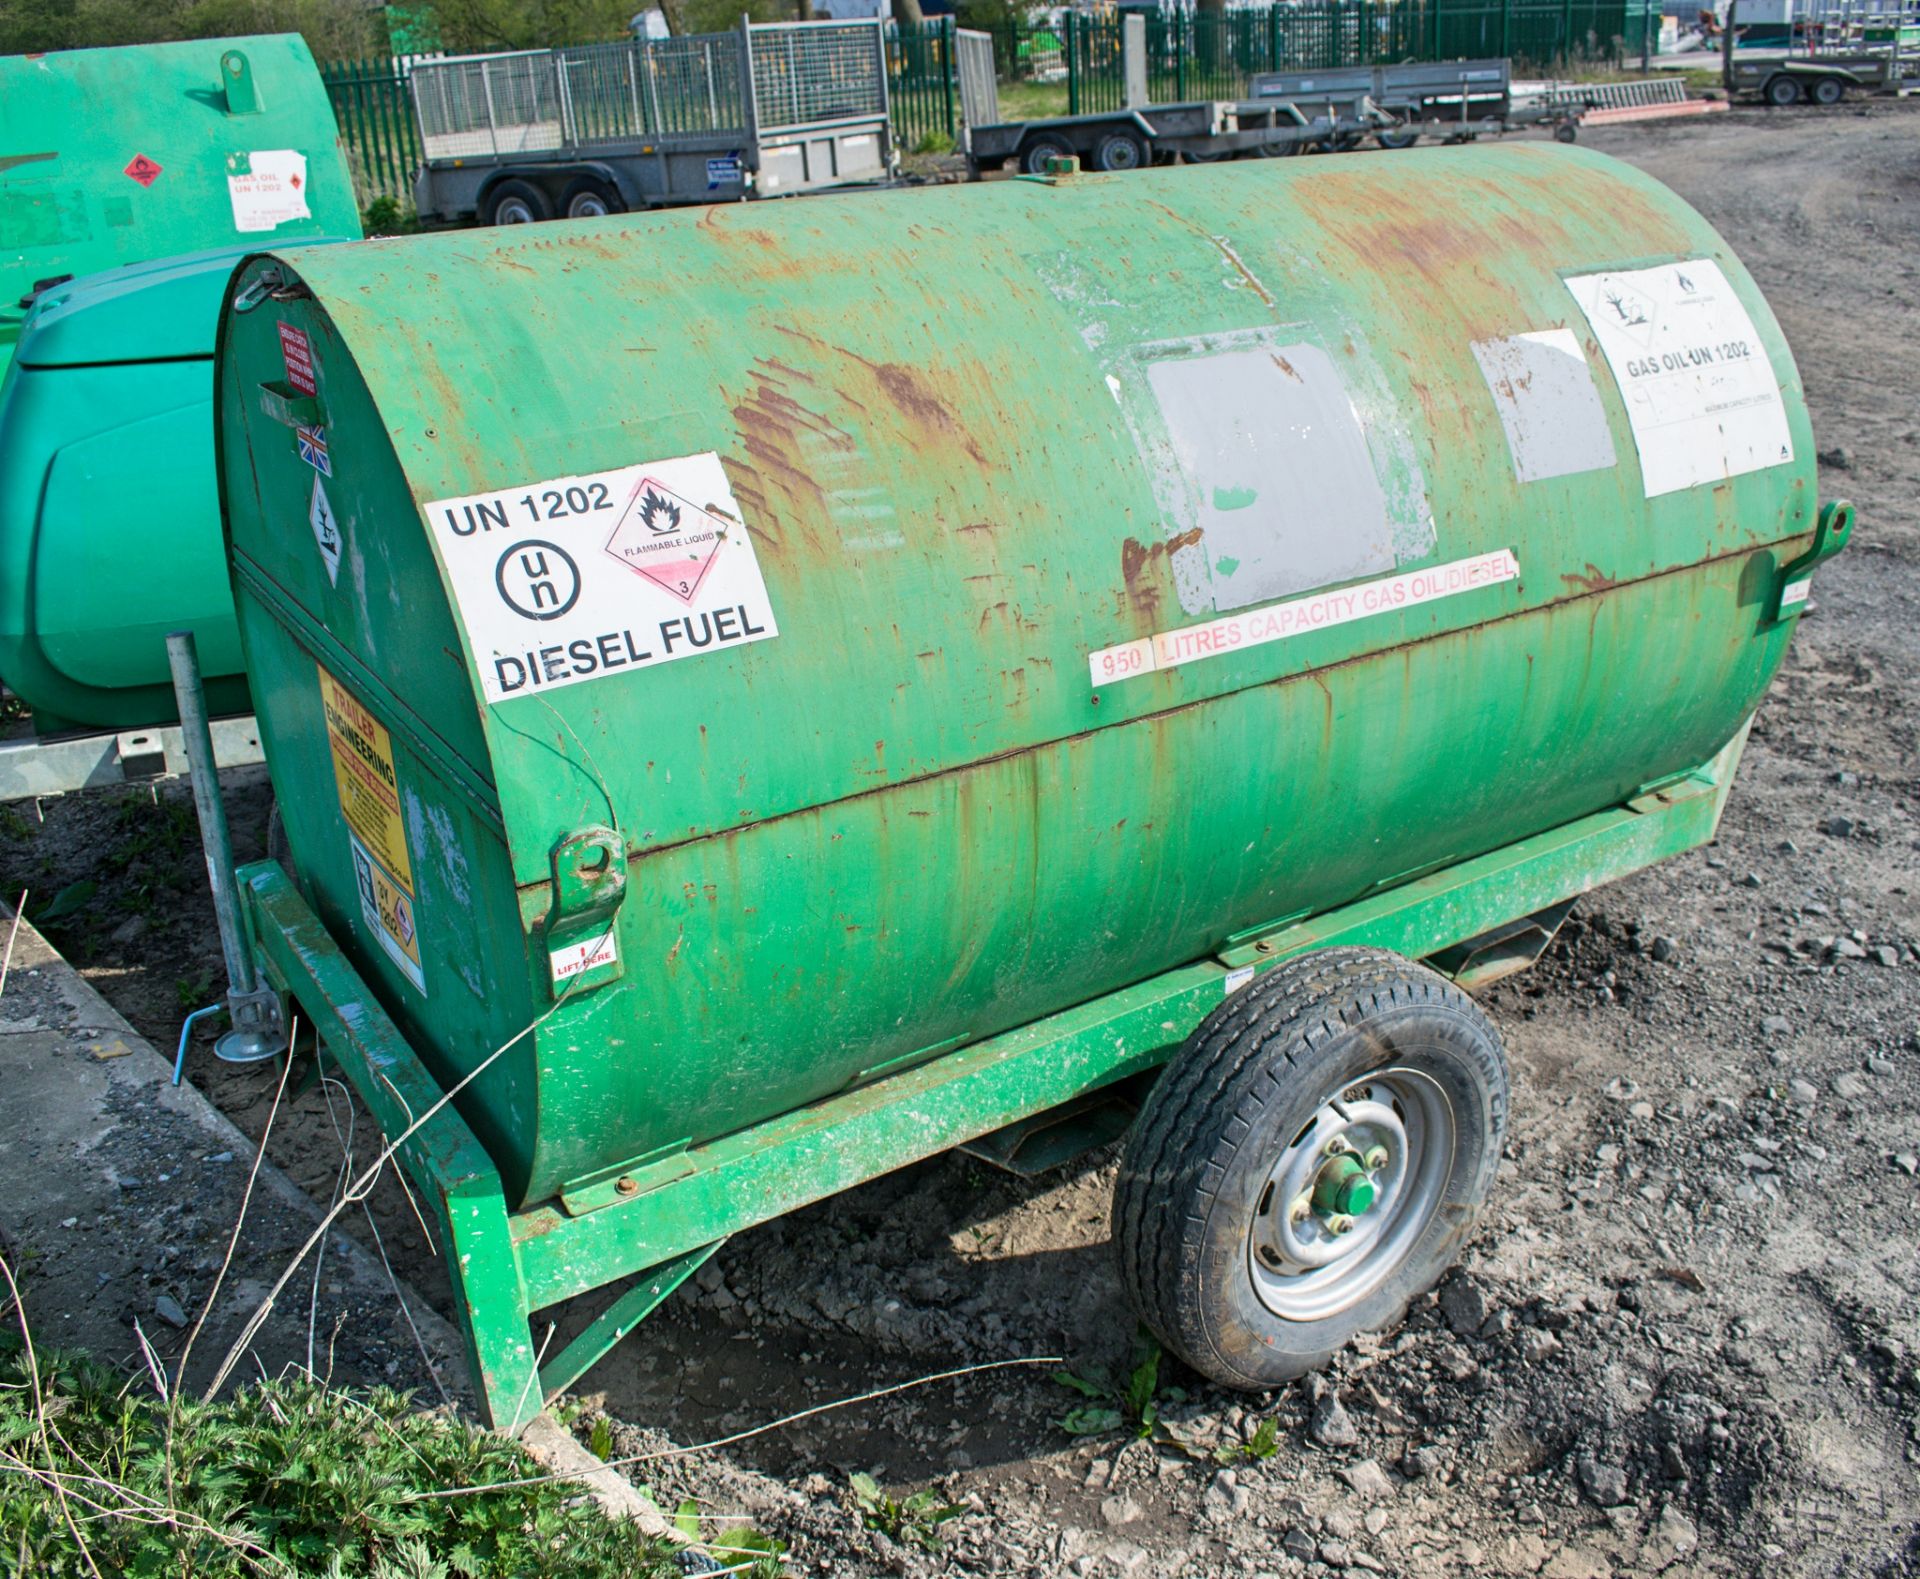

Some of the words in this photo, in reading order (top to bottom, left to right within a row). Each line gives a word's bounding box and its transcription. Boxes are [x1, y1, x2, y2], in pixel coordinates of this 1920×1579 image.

[234, 174, 256, 183] GAS
[260, 173, 278, 181] OIL
[256, 183, 281, 191] 1202
[1627, 356, 1660, 377] GAS
[1663, 352, 1689, 371] OIL
[1691, 350, 1713, 366] UN
[1716, 340, 1750, 361] 1202
[446, 500, 510, 537] UN
[520, 482, 614, 522] 1202
[624, 538, 684, 557] FLAMMABLE
[685, 532, 715, 545] LIQUID
[679, 581, 689, 593] 3
[1102, 647, 1142, 676] 950
[1160, 623, 1242, 661] LITRES
[1249, 592, 1356, 639] CAPACITY
[1362, 579, 1406, 611] GAS
[494, 629, 652, 693] DIESEL
[659, 604, 765, 655] FUEL
[332, 684, 377, 746] TRAILER
[325, 701, 395, 789] ENGINEERING
[557, 961, 579, 975] LIFT
